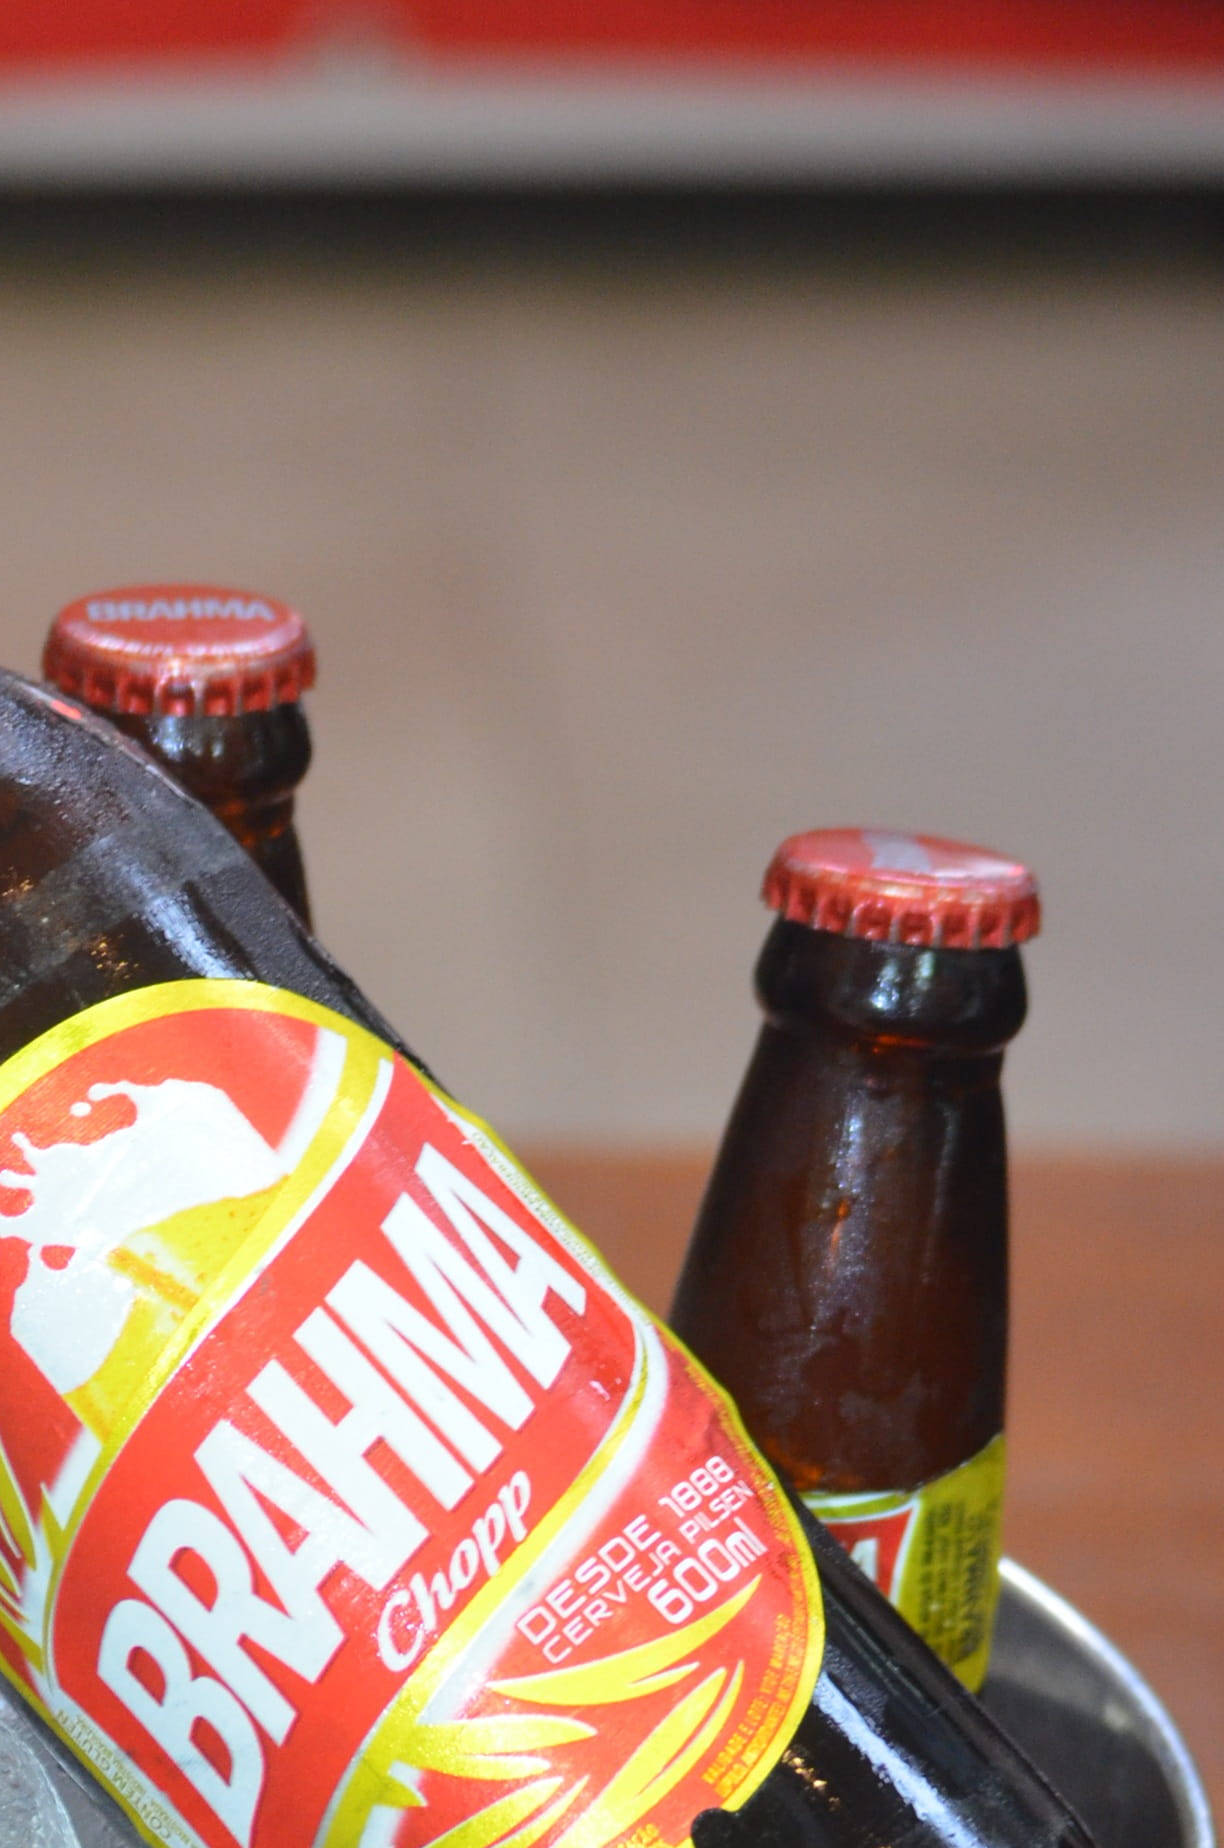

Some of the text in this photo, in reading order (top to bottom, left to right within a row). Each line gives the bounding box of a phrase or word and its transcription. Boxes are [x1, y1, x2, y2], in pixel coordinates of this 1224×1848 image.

[87, 599, 274, 621] BRAHMA
[378, 1471, 531, 1671] Chopp
[516, 1455, 736, 1646] DESDE 1888
[543, 1480, 755, 1664] CERVEJA PILSEN
[648, 1516, 767, 1624] 600ml
